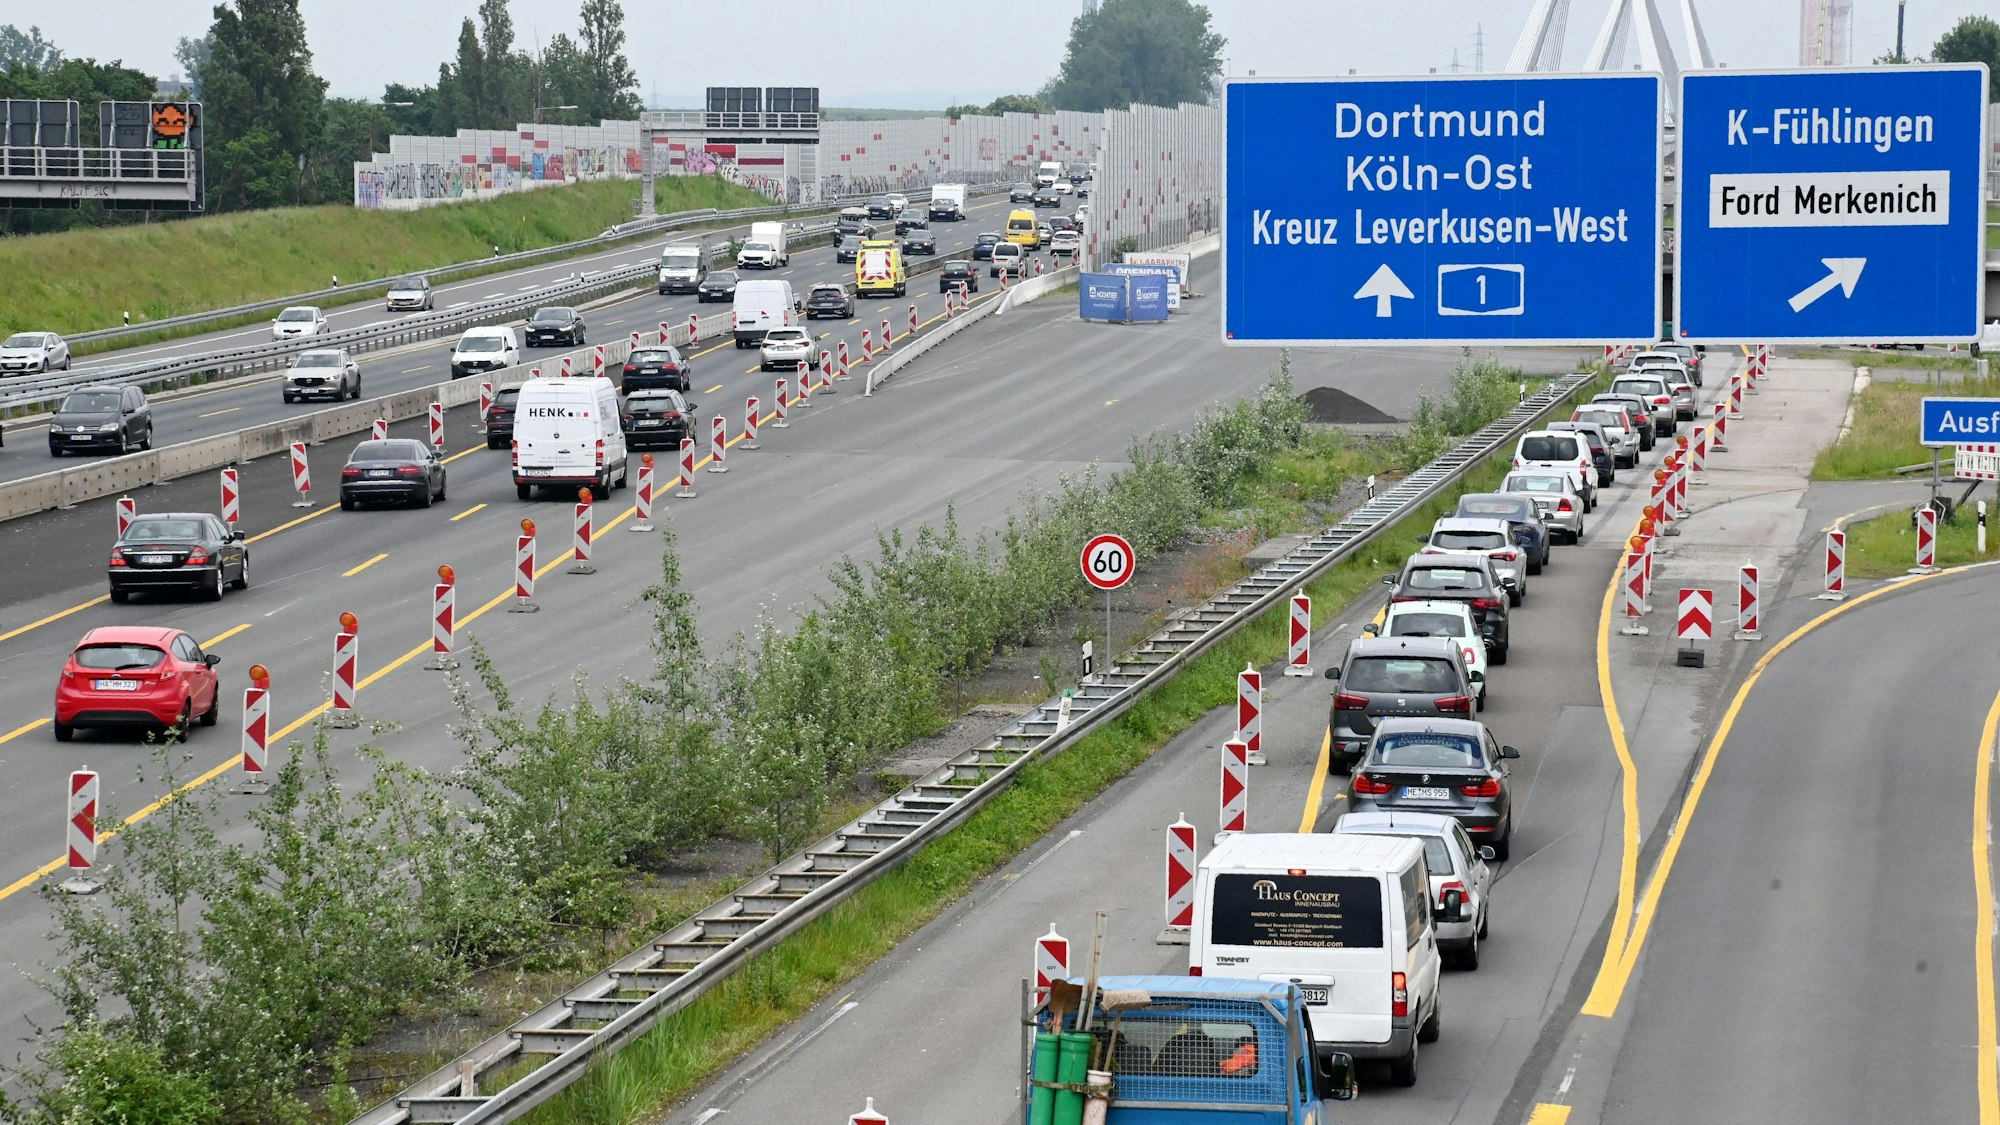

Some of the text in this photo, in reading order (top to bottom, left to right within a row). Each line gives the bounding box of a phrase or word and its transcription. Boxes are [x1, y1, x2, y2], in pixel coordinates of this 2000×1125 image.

[1335, 100, 1545, 139] Dortmund
[1727, 107, 1934, 153] K-Fühlingen
[1346, 154, 1533, 191] Köln-Ost
[1721, 183, 1937, 216] Ford Merkenich
[1253, 207, 1629, 245] Kreuz Leverkusen-West
[1475, 274, 1486, 305] 1
[529, 407, 566, 418] HENK
[1938, 409, 2000, 434] Ausf
[1093, 550, 1122, 573] 60
[1407, 788, 1448, 798] ME MS 955
[1293, 889, 1340, 902] CONCEPT
[1253, 939, 1343, 947] www.haus-concept.com
